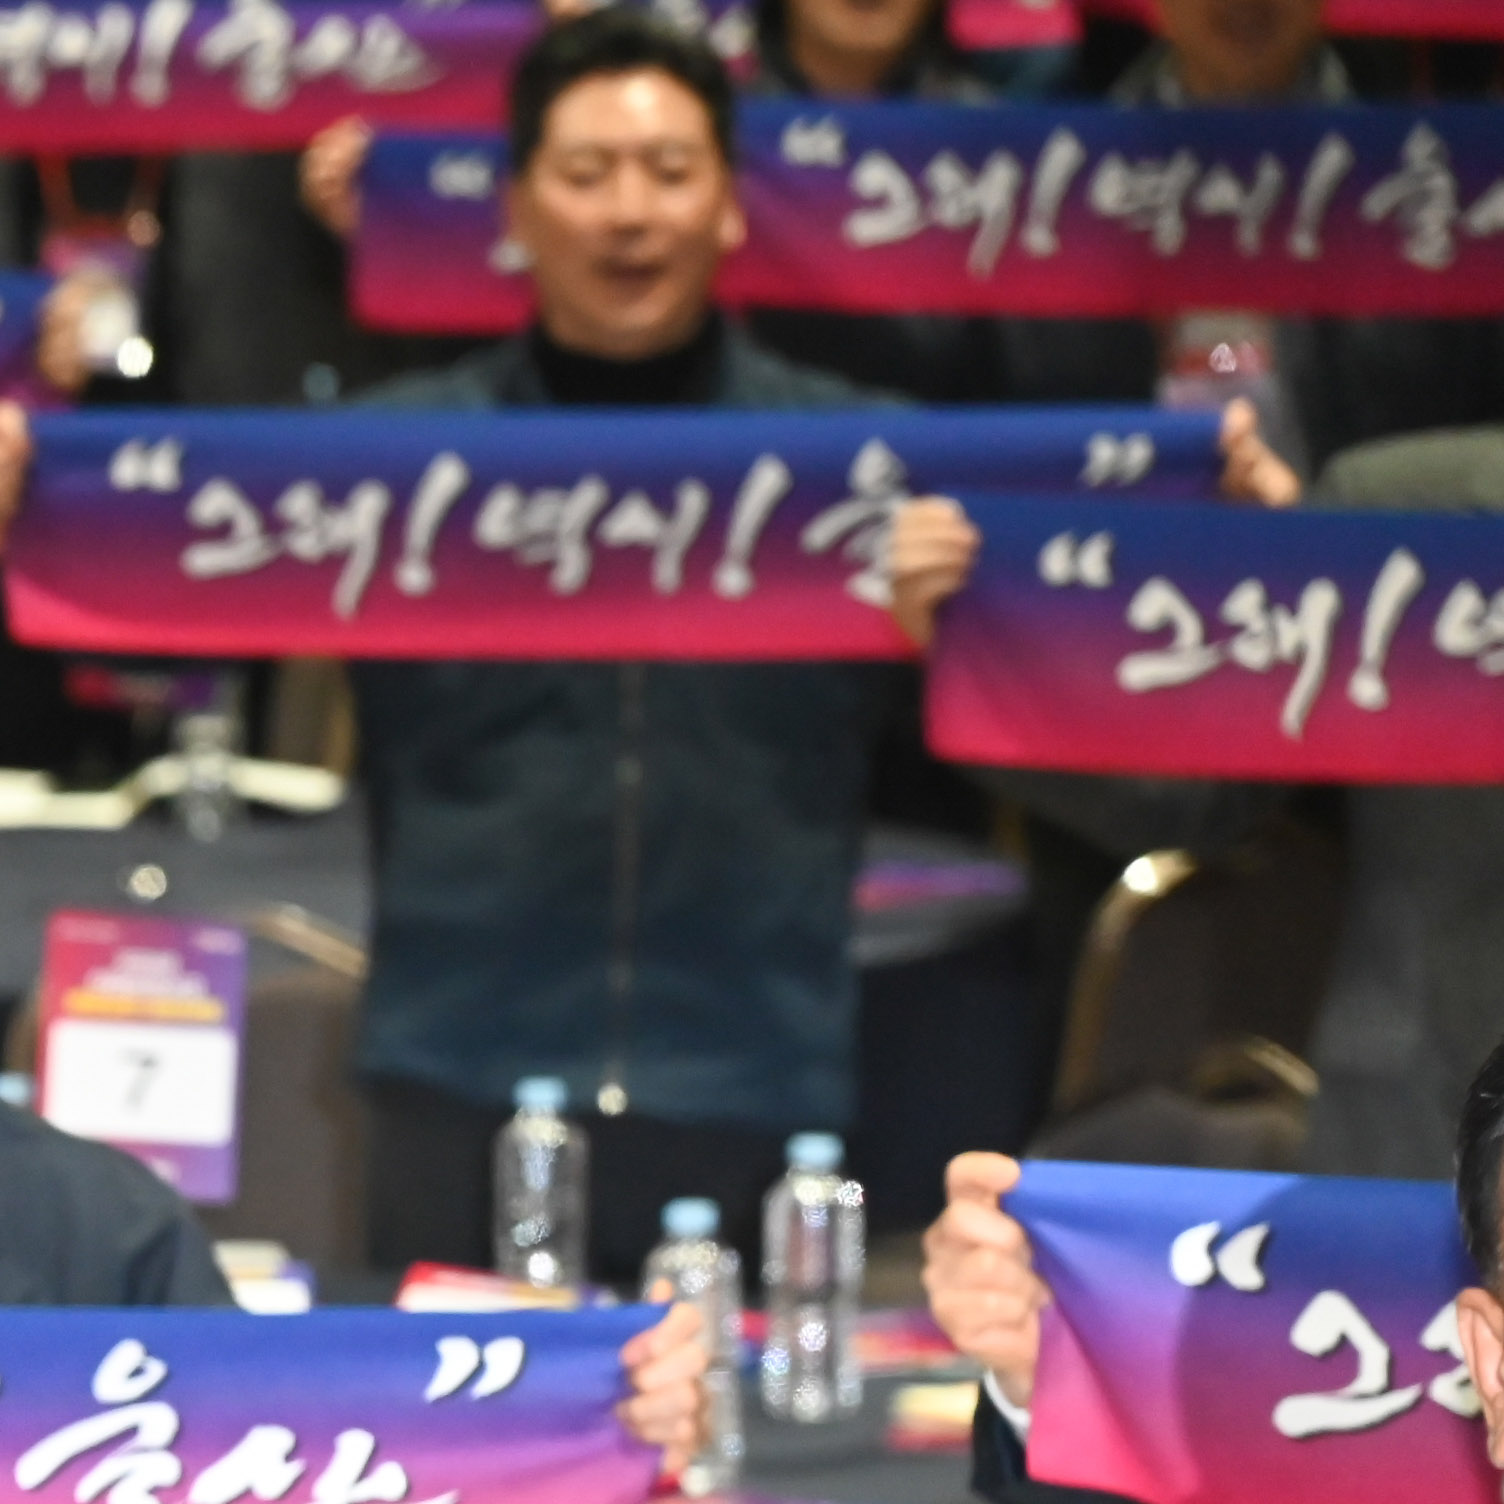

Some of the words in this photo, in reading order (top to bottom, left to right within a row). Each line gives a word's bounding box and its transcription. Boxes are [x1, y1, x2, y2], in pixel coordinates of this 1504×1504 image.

[1086, 130, 1358, 262] 역시!
[475, 455, 788, 598] 역시!
[120, 1044, 163, 1110] 7
